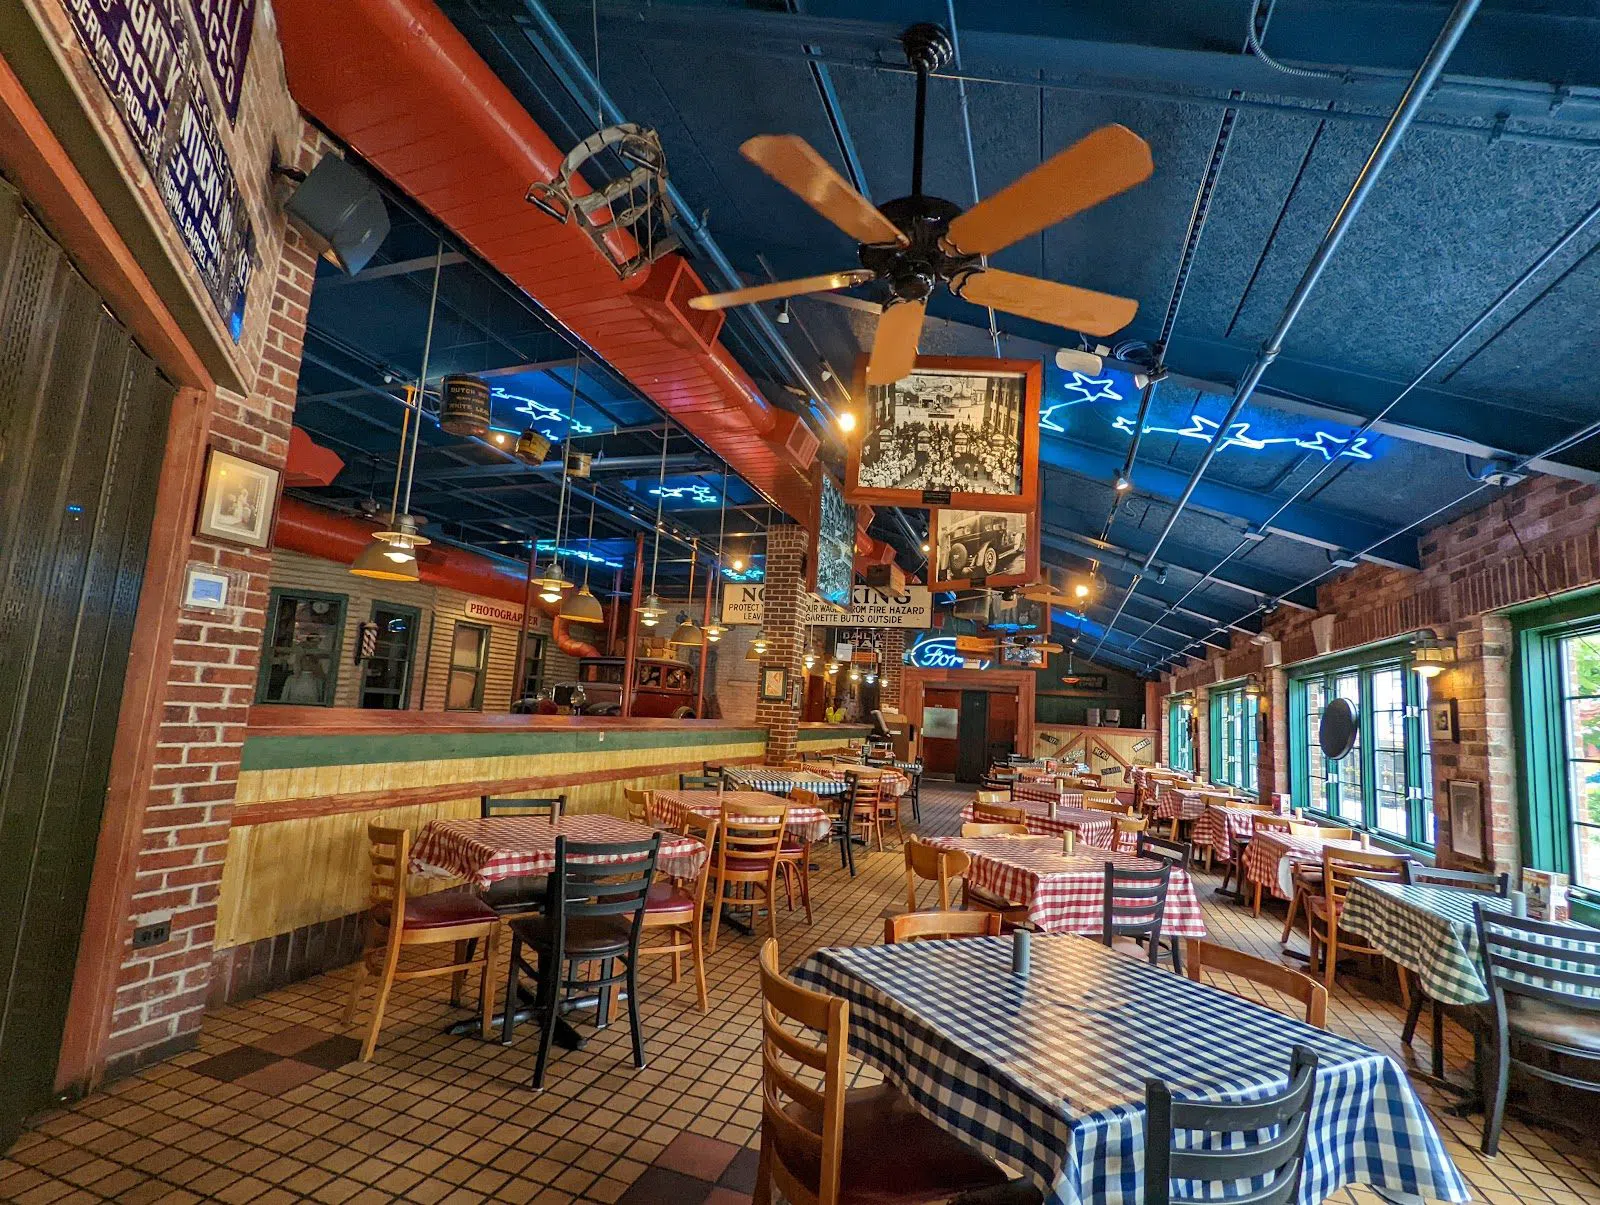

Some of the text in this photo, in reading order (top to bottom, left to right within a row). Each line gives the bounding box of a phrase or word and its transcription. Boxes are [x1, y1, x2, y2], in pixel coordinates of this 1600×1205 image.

[164, 52, 221, 216] KNTUCKY
[117, 71, 147, 137] FROM
[163, 164, 186, 228] RIGINAL
[184, 214, 207, 270] BARREL
[187, 180, 201, 219] IN
[470, 603, 538, 626] PHOTOGRAPER
[728, 603, 760, 612] PROTECT
[852, 606, 867, 614] ROM
[869, 606, 886, 614] FIRE
[889, 606, 925, 615] HAZARD
[805, 613, 838, 623] GARETTE
[840, 614, 865, 623] BUTTS
[867, 615, 903, 624] OUTSIDE
[920, 643, 964, 667] For
